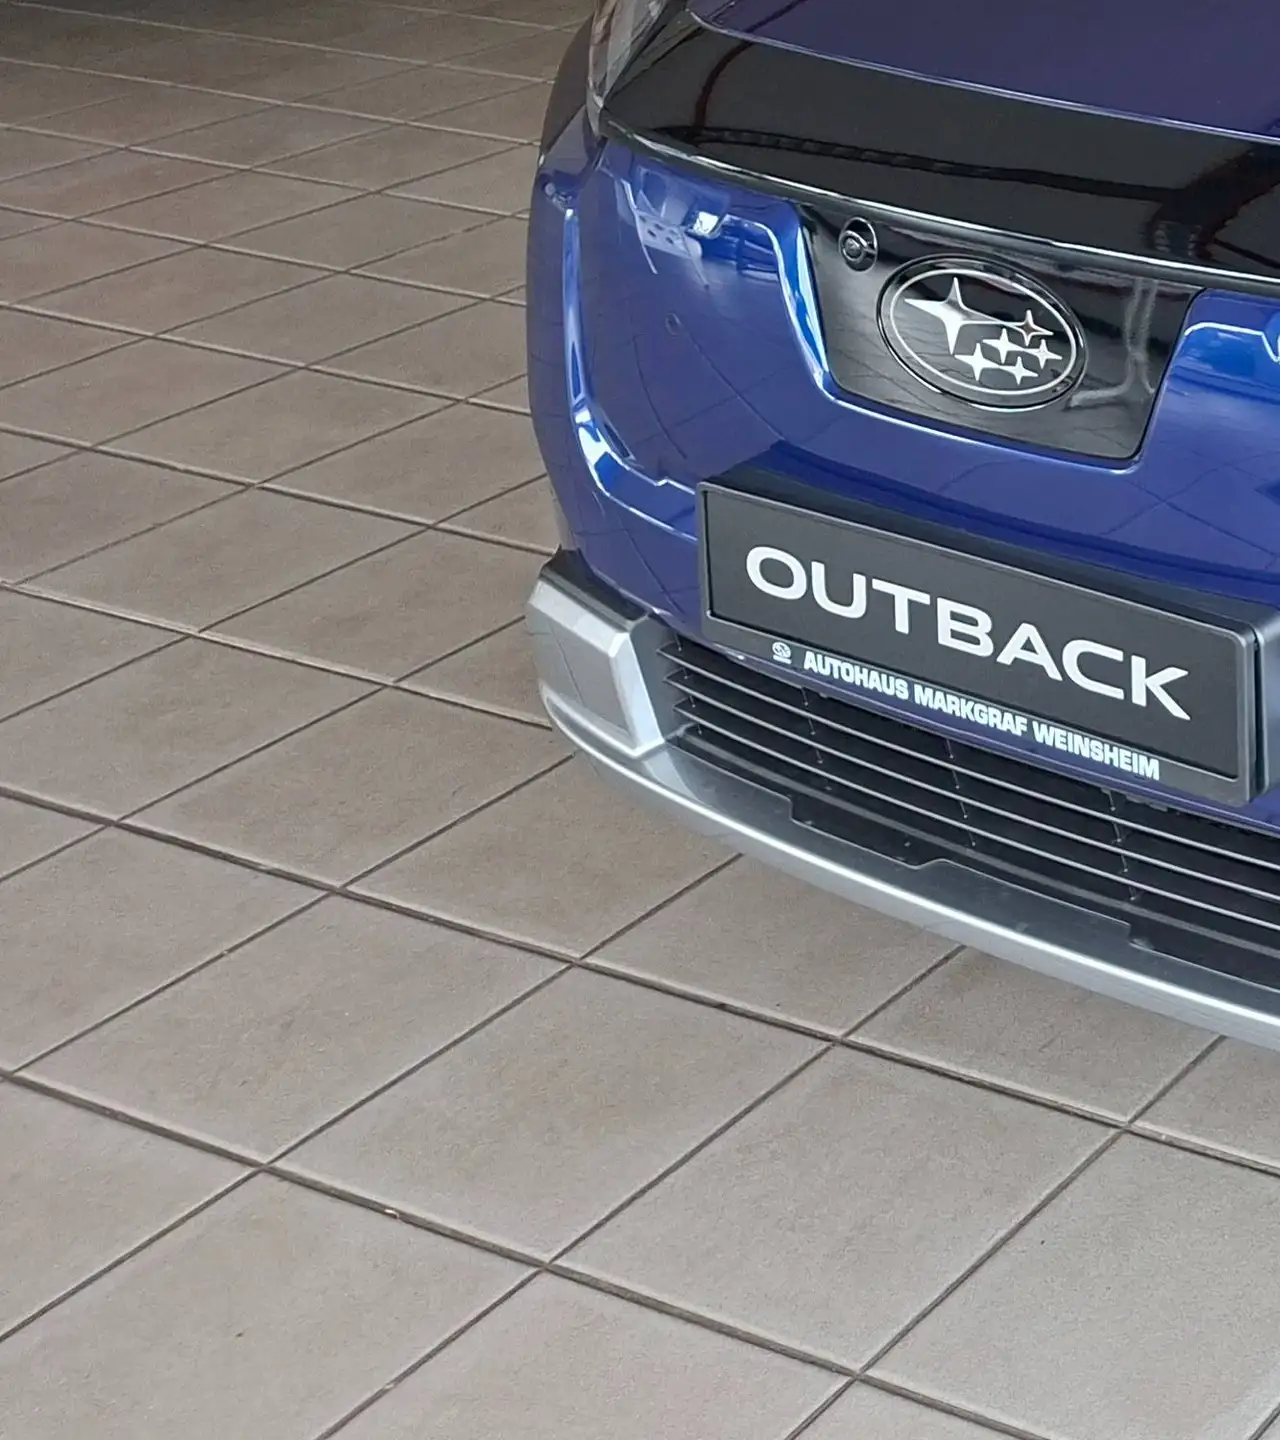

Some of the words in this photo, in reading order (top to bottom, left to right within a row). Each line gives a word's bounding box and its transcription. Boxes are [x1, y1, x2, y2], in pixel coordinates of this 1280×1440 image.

[745, 545, 1191, 721] OUTBACK
[803, 649, 910, 701] AUTOHAUS
[913, 684, 1029, 738] MARKGRAF
[1032, 720, 1161, 782] WEINSHEIM
